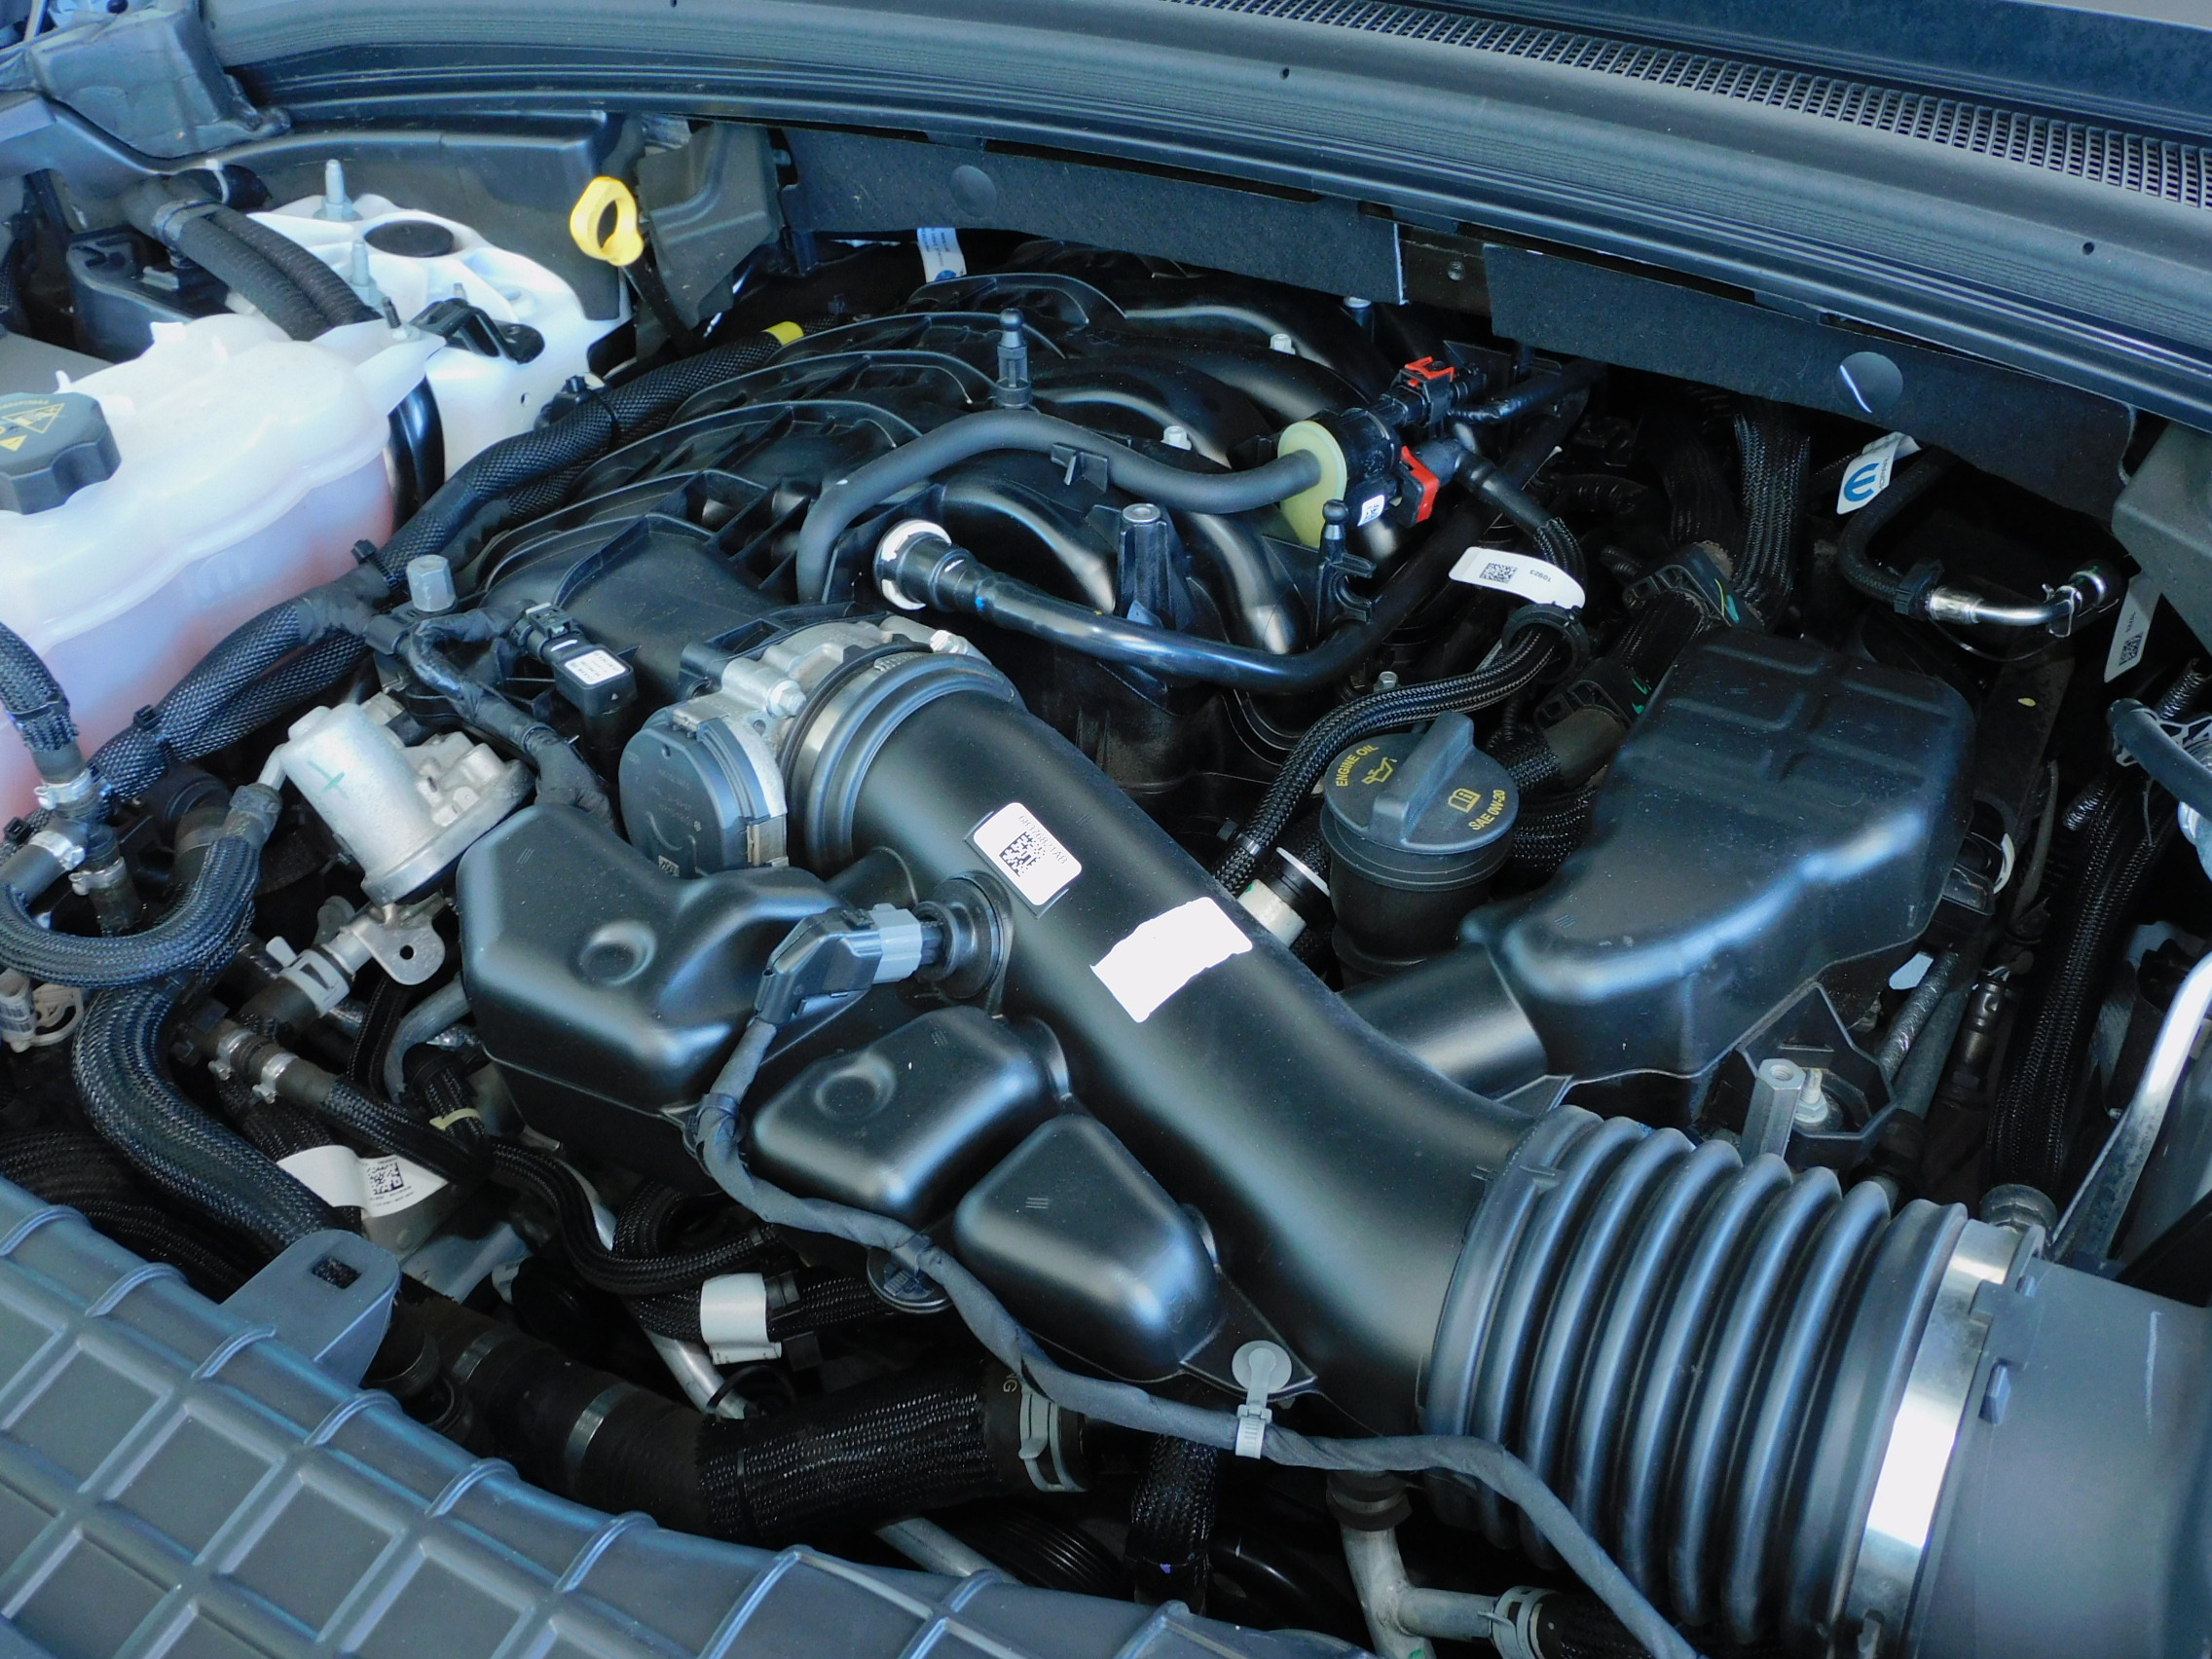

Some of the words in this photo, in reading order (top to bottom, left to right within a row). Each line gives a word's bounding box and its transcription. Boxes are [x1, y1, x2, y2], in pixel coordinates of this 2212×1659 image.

[1336, 755, 1360, 787] ENGINE
[1356, 743, 1380, 757] OIL
[1468, 813, 1495, 830] SAE
[1488, 790, 1505, 815] 0W-20
